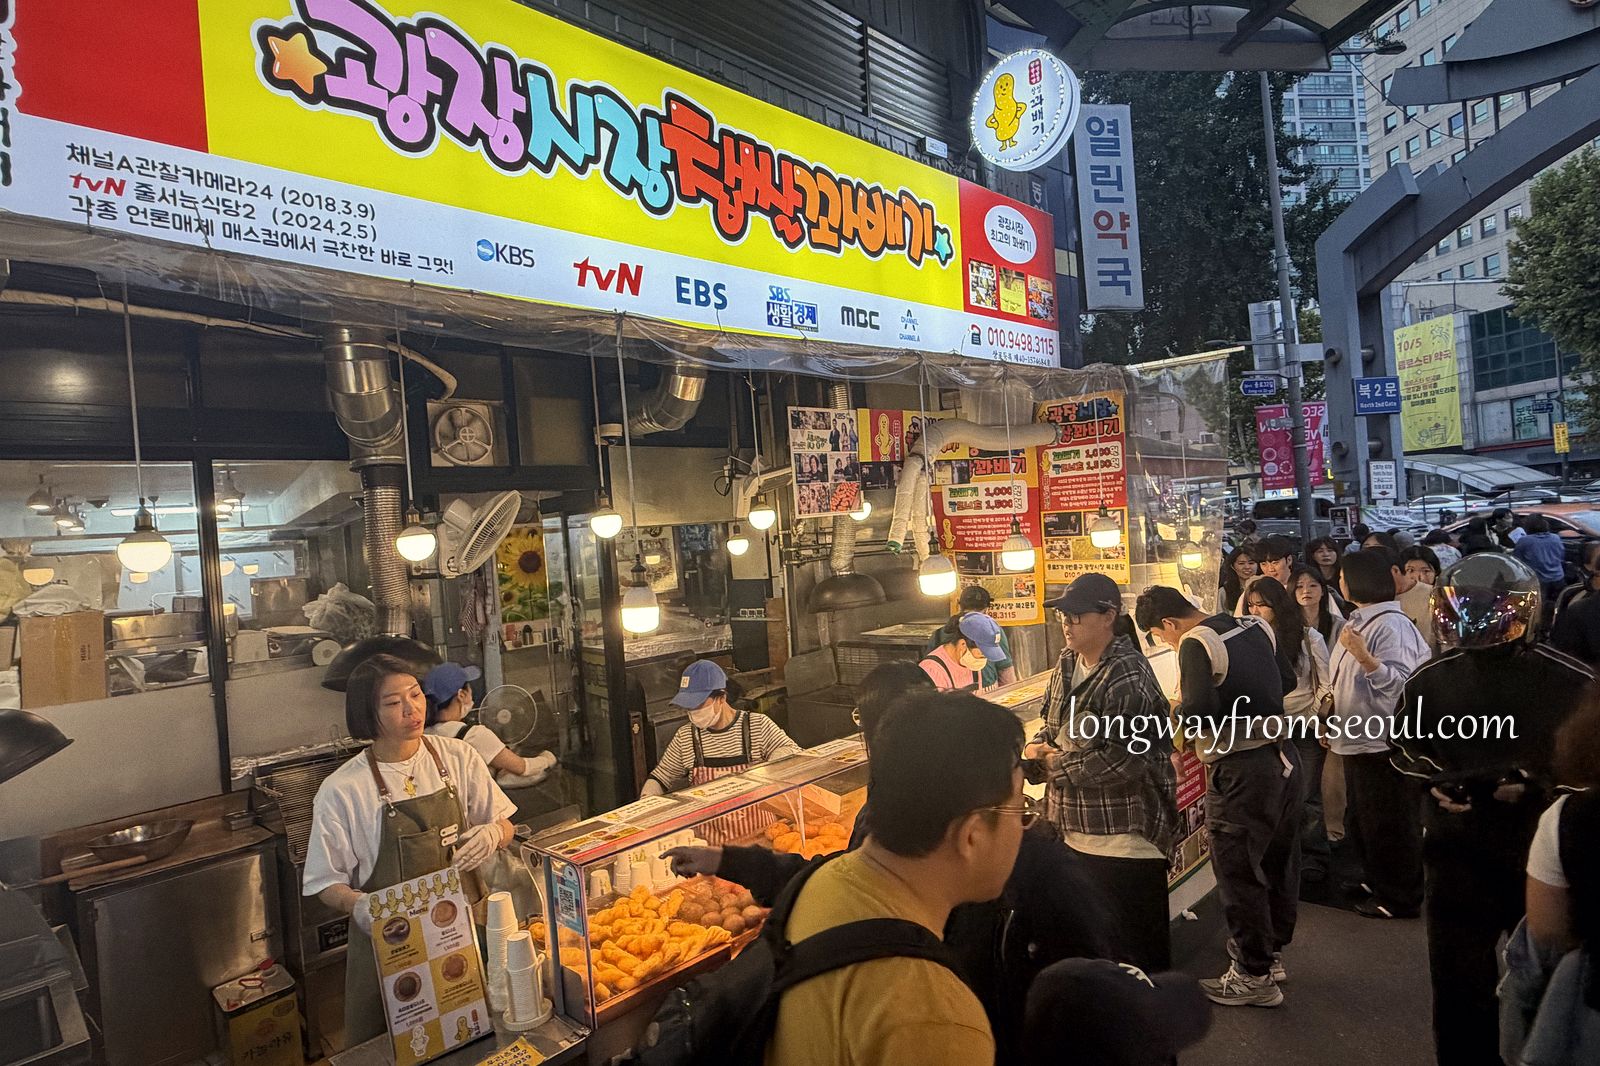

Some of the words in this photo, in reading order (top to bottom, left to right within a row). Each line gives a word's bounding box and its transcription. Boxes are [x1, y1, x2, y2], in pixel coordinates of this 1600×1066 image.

[1029, 94, 1045, 135] 꽈배기
[69, 172, 126, 197] tvN
[133, 181, 256, 220] 줄서는식당2
[272, 207, 377, 242] (2024.2.5)
[281, 187, 375, 221] (2018.3.9)
[68, 194, 119, 221] 각종
[126, 204, 215, 237] 언론매체
[222, 221, 316, 253] 매스컴에서
[322, 238, 375, 262] 극찬한
[380, 248, 413, 268] 바로
[417, 255, 454, 275] 그맛!
[997, 215, 1024, 235] 광장시장
[495, 242, 535, 268] KBS
[573, 256, 644, 297] tvN
[675, 275, 728, 310] EBS
[768, 284, 791, 303] SBS
[987, 326, 1055, 356] 010.9498.3115
